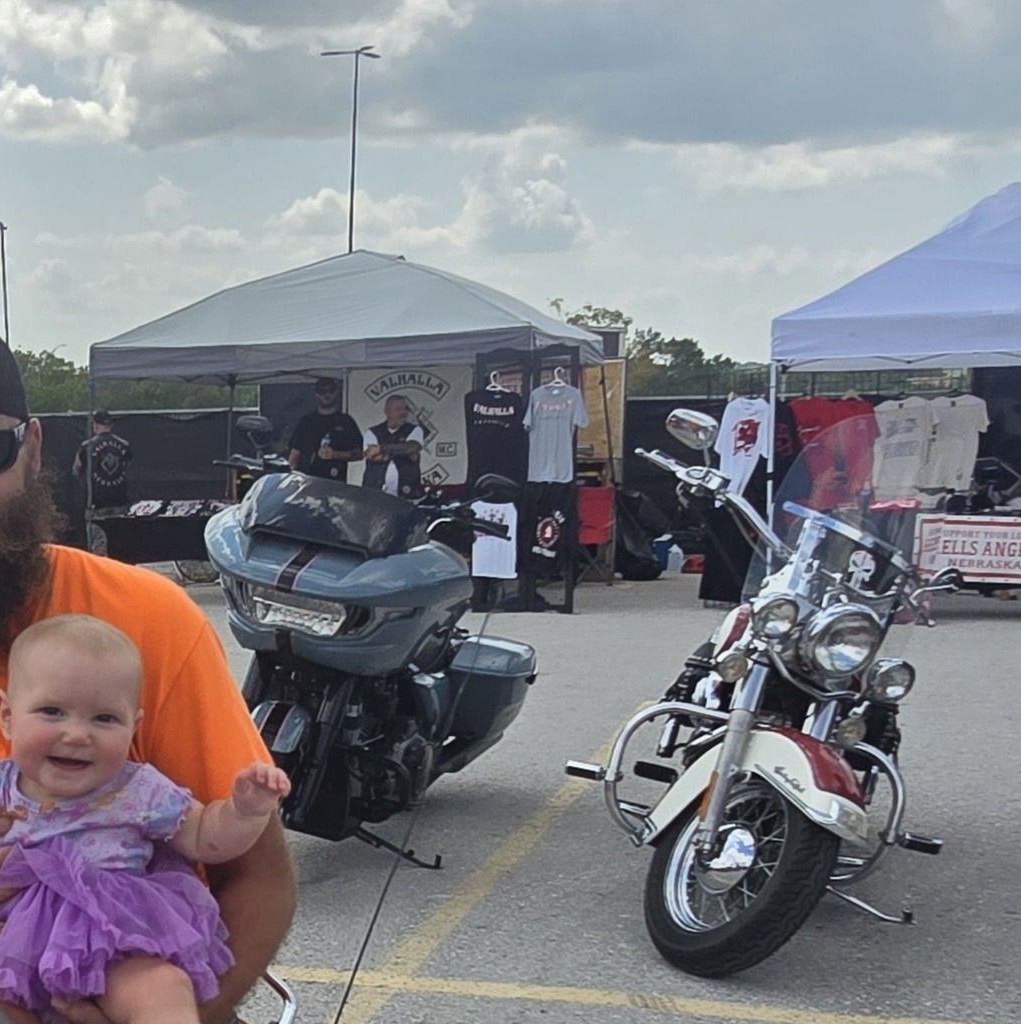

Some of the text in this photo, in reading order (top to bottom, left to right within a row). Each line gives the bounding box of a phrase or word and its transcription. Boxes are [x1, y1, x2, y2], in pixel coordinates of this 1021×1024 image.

[369, 373, 445, 397] VALHALLA
[942, 529, 981, 539] UPPORT
[942, 539, 978, 556] ELLS
[982, 541, 1021, 558] ANG
[948, 558, 1021, 570] NEBRASKA
